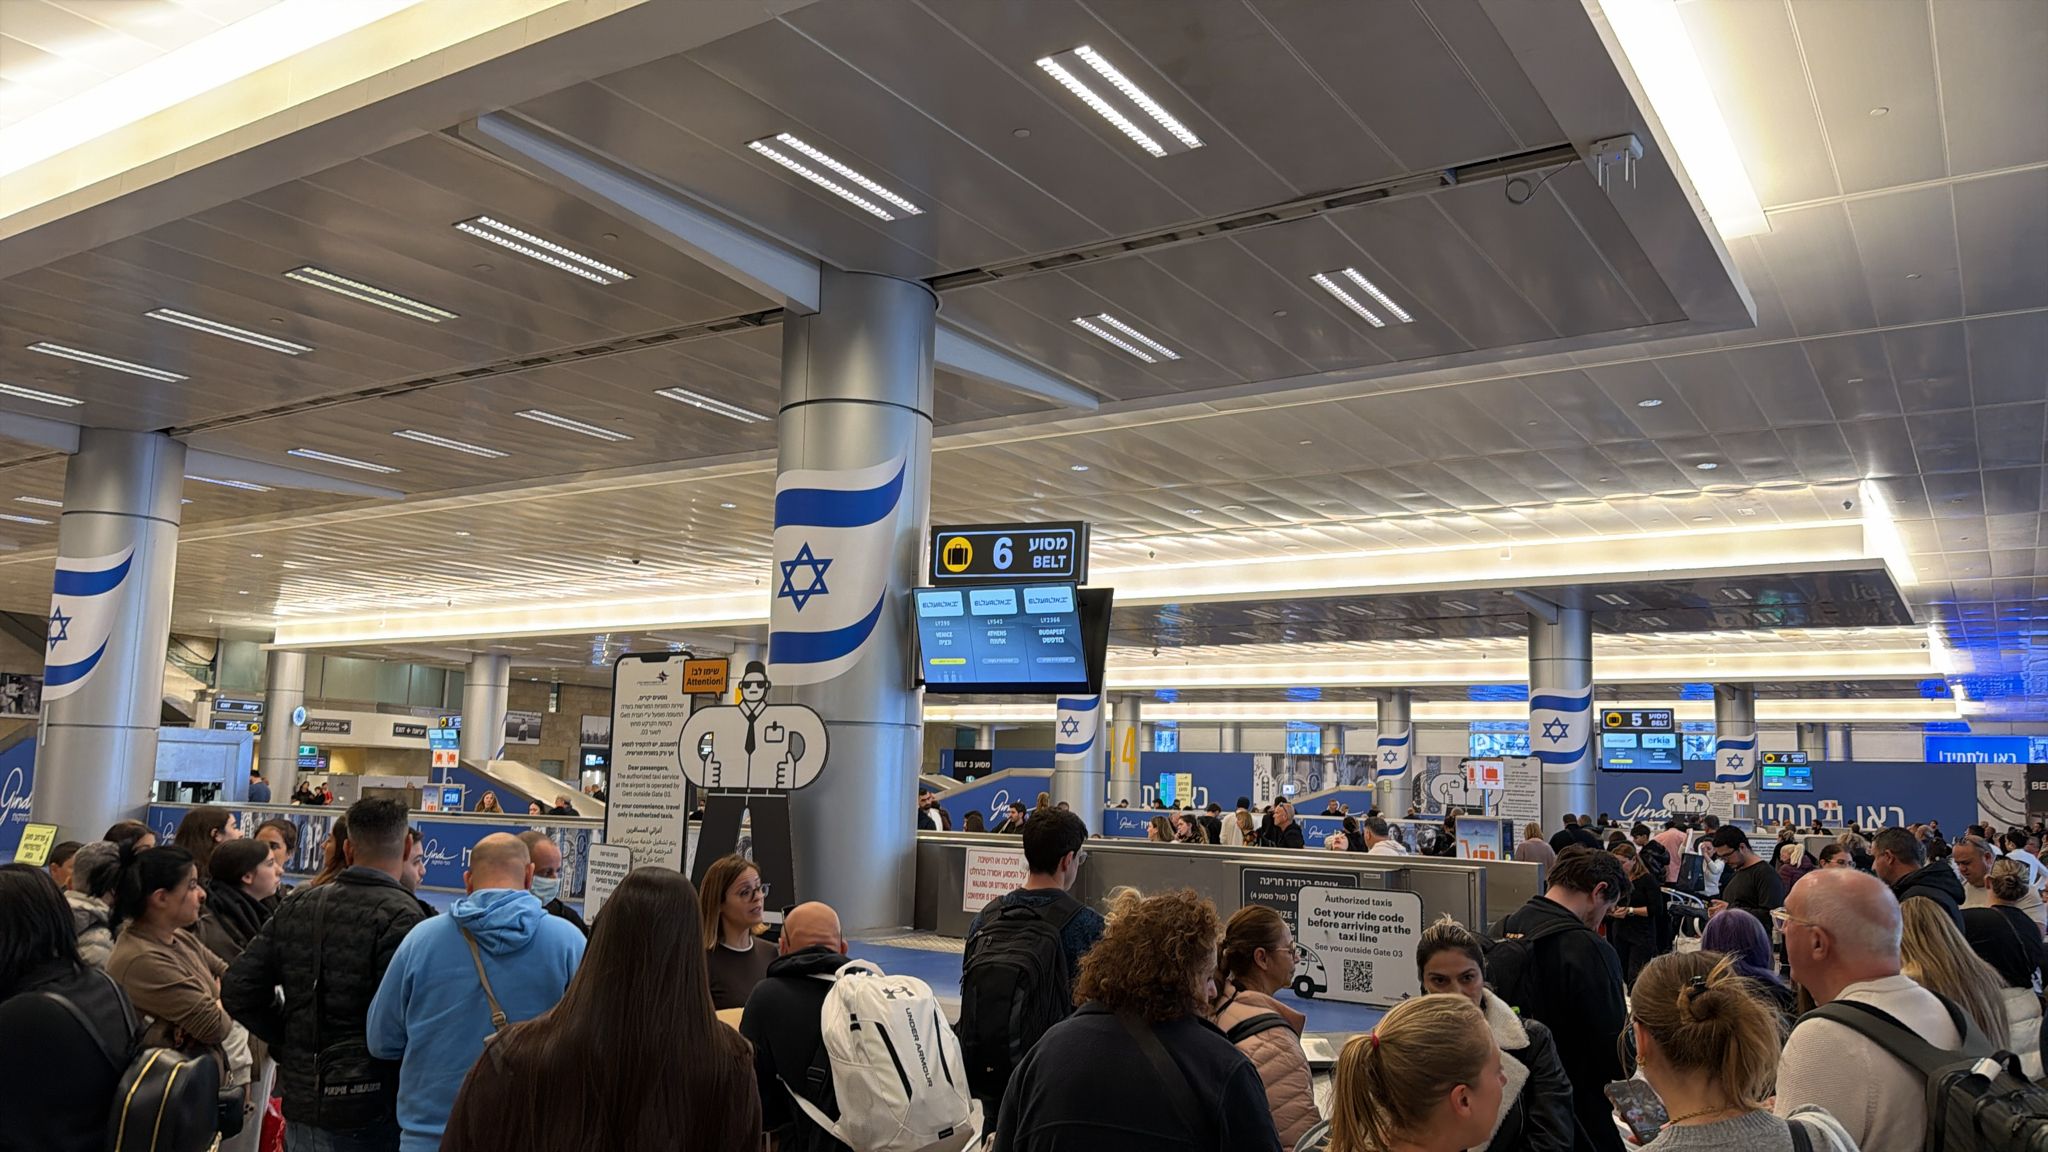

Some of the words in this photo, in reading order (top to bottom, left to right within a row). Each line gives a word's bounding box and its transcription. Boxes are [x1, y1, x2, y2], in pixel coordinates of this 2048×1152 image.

[1028, 537, 1068, 552] מסוע
[993, 537, 1013, 570] 6
[1033, 556, 1066, 568] BELT
[692, 667, 702, 675] לב!
[687, 676, 723, 686] Attention!
[1632, 713, 1642, 726] 5
[1122, 727, 1136, 775] 4
[1260, 877, 1284, 886] חריגה
[1325, 895, 1370, 906] Authorized
[1372, 898, 1392, 907] taxis
[1314, 908, 1331, 917] Get
[1333, 910, 1354, 920] your
[1357, 910, 1377, 920] ride
[1379, 912, 1404, 923] code
[1308, 918, 1339, 929] before
[1341, 921, 1380, 934] arriving
[1382, 924, 1392, 933] at
[1393, 924, 1411, 935] the
[1339, 932, 1357, 942] taxi
[1359, 933, 1378, 943] line
[1344, 946, 1372, 955] outside
[906, 1008, 919, 1041] UNDER
[915, 1043, 933, 1087] ARMOUR
